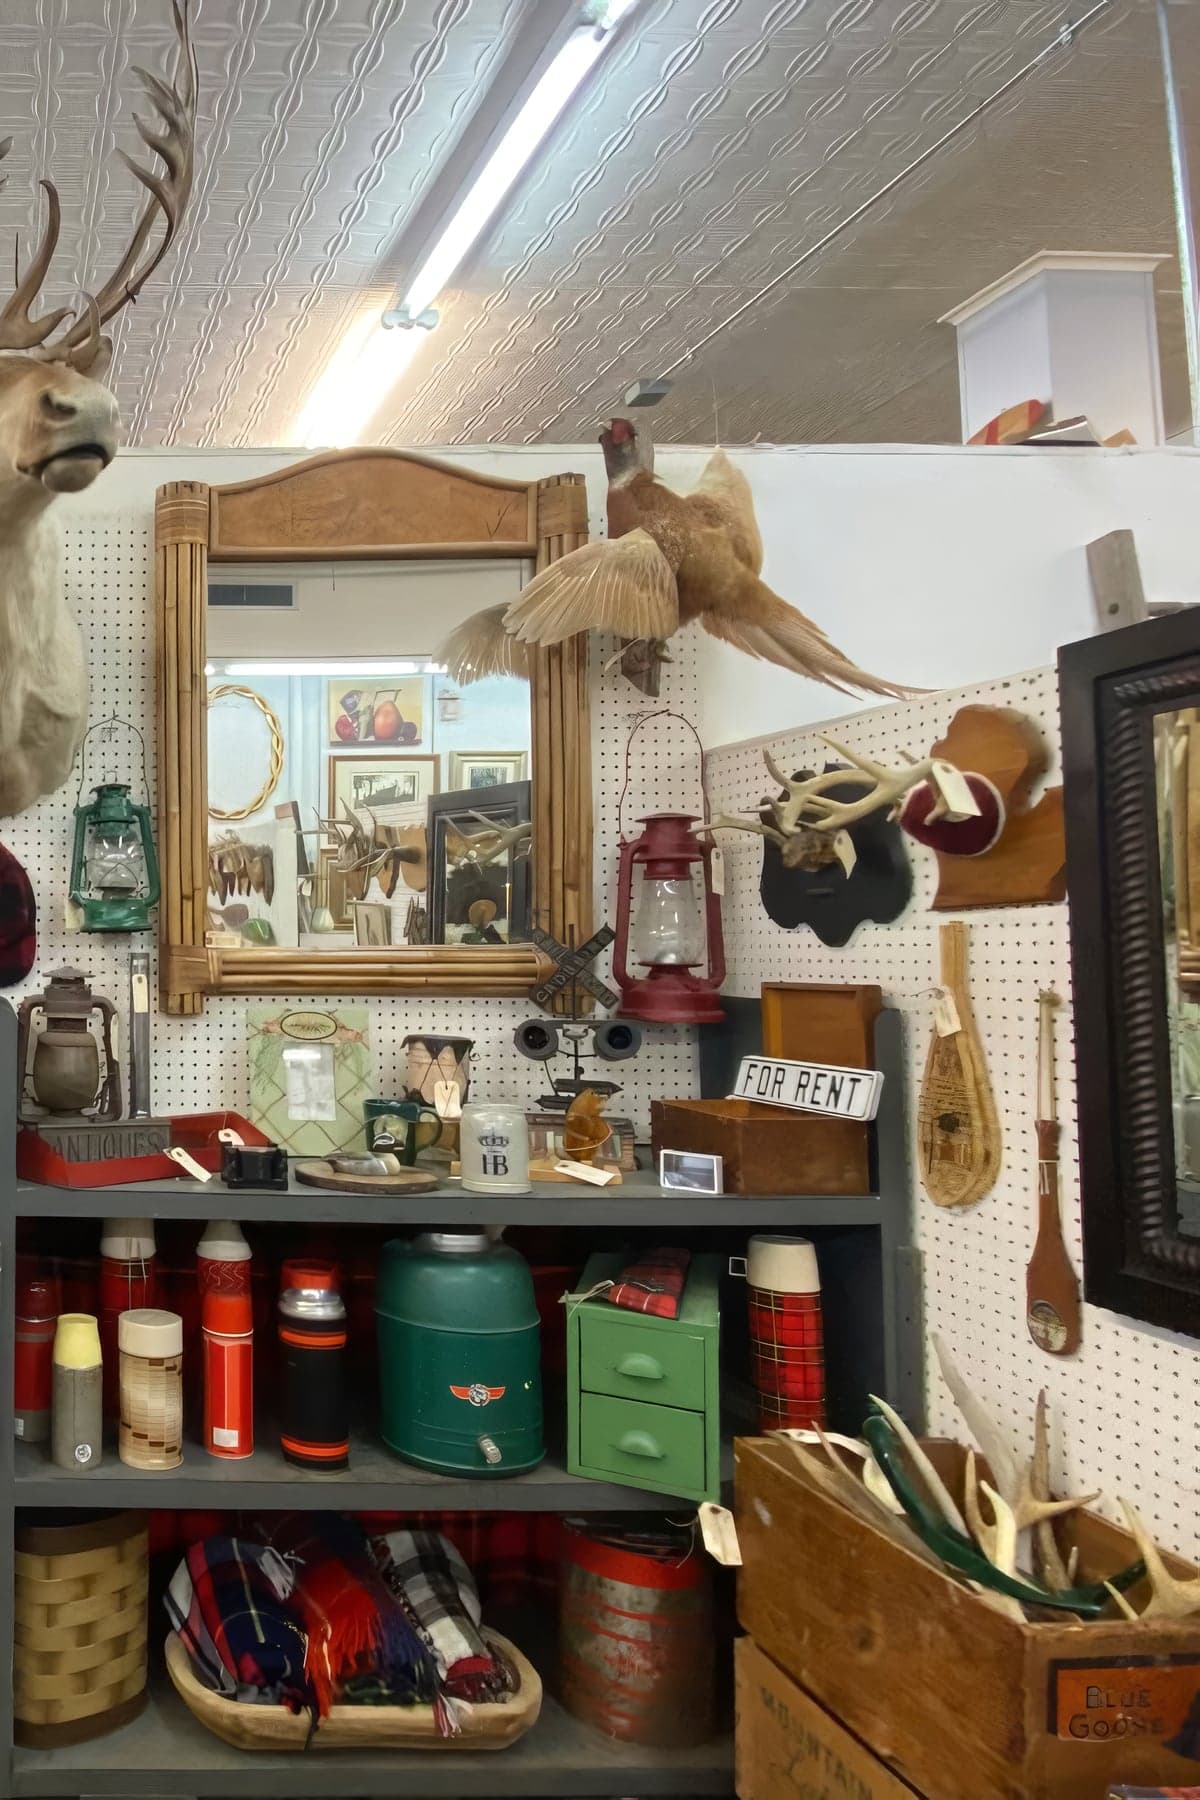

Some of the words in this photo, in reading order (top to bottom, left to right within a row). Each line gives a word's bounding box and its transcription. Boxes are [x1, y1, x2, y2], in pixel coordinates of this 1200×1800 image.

[742, 1063, 786, 1099] FOR
[795, 1071, 861, 1112] RENT
[1086, 1685, 1151, 1709] BLUE
